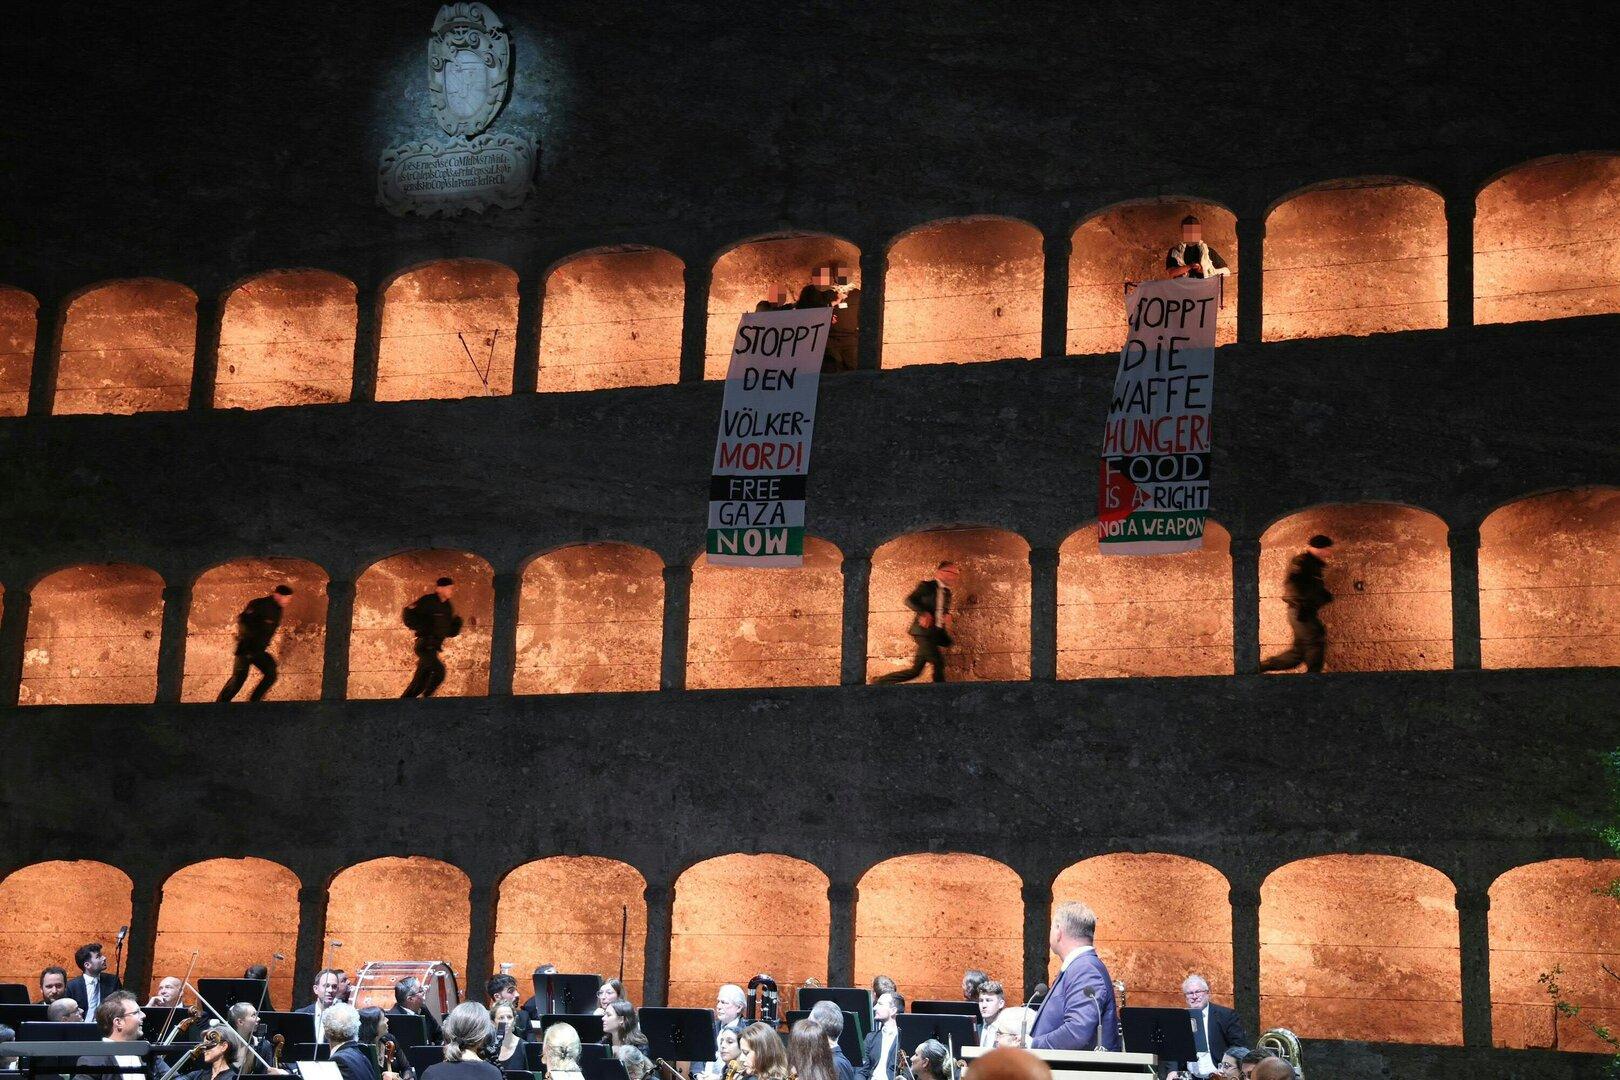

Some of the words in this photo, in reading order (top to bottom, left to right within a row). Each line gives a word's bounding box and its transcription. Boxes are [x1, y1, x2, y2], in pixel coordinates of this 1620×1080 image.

[735, 323, 825, 358] STOPPT
[743, 367, 797, 391] DEN
[724, 407, 811, 438] VÖLKER-
[1103, 413, 1213, 454] HUNGER!
[719, 442, 803, 473] MORD!
[1105, 454, 1203, 485] FOOD
[729, 478, 781, 500] FREE
[1105, 485, 1121, 509] IS
[1131, 486, 1144, 507] A
[1153, 485, 1210, 510] RIGHT
[720, 502, 786, 527] GAZA
[1099, 517, 1127, 538] NOT
[1127, 518, 1138, 536] A
[1141, 517, 1205, 537] WEAPON
[717, 528, 788, 556] NOW
